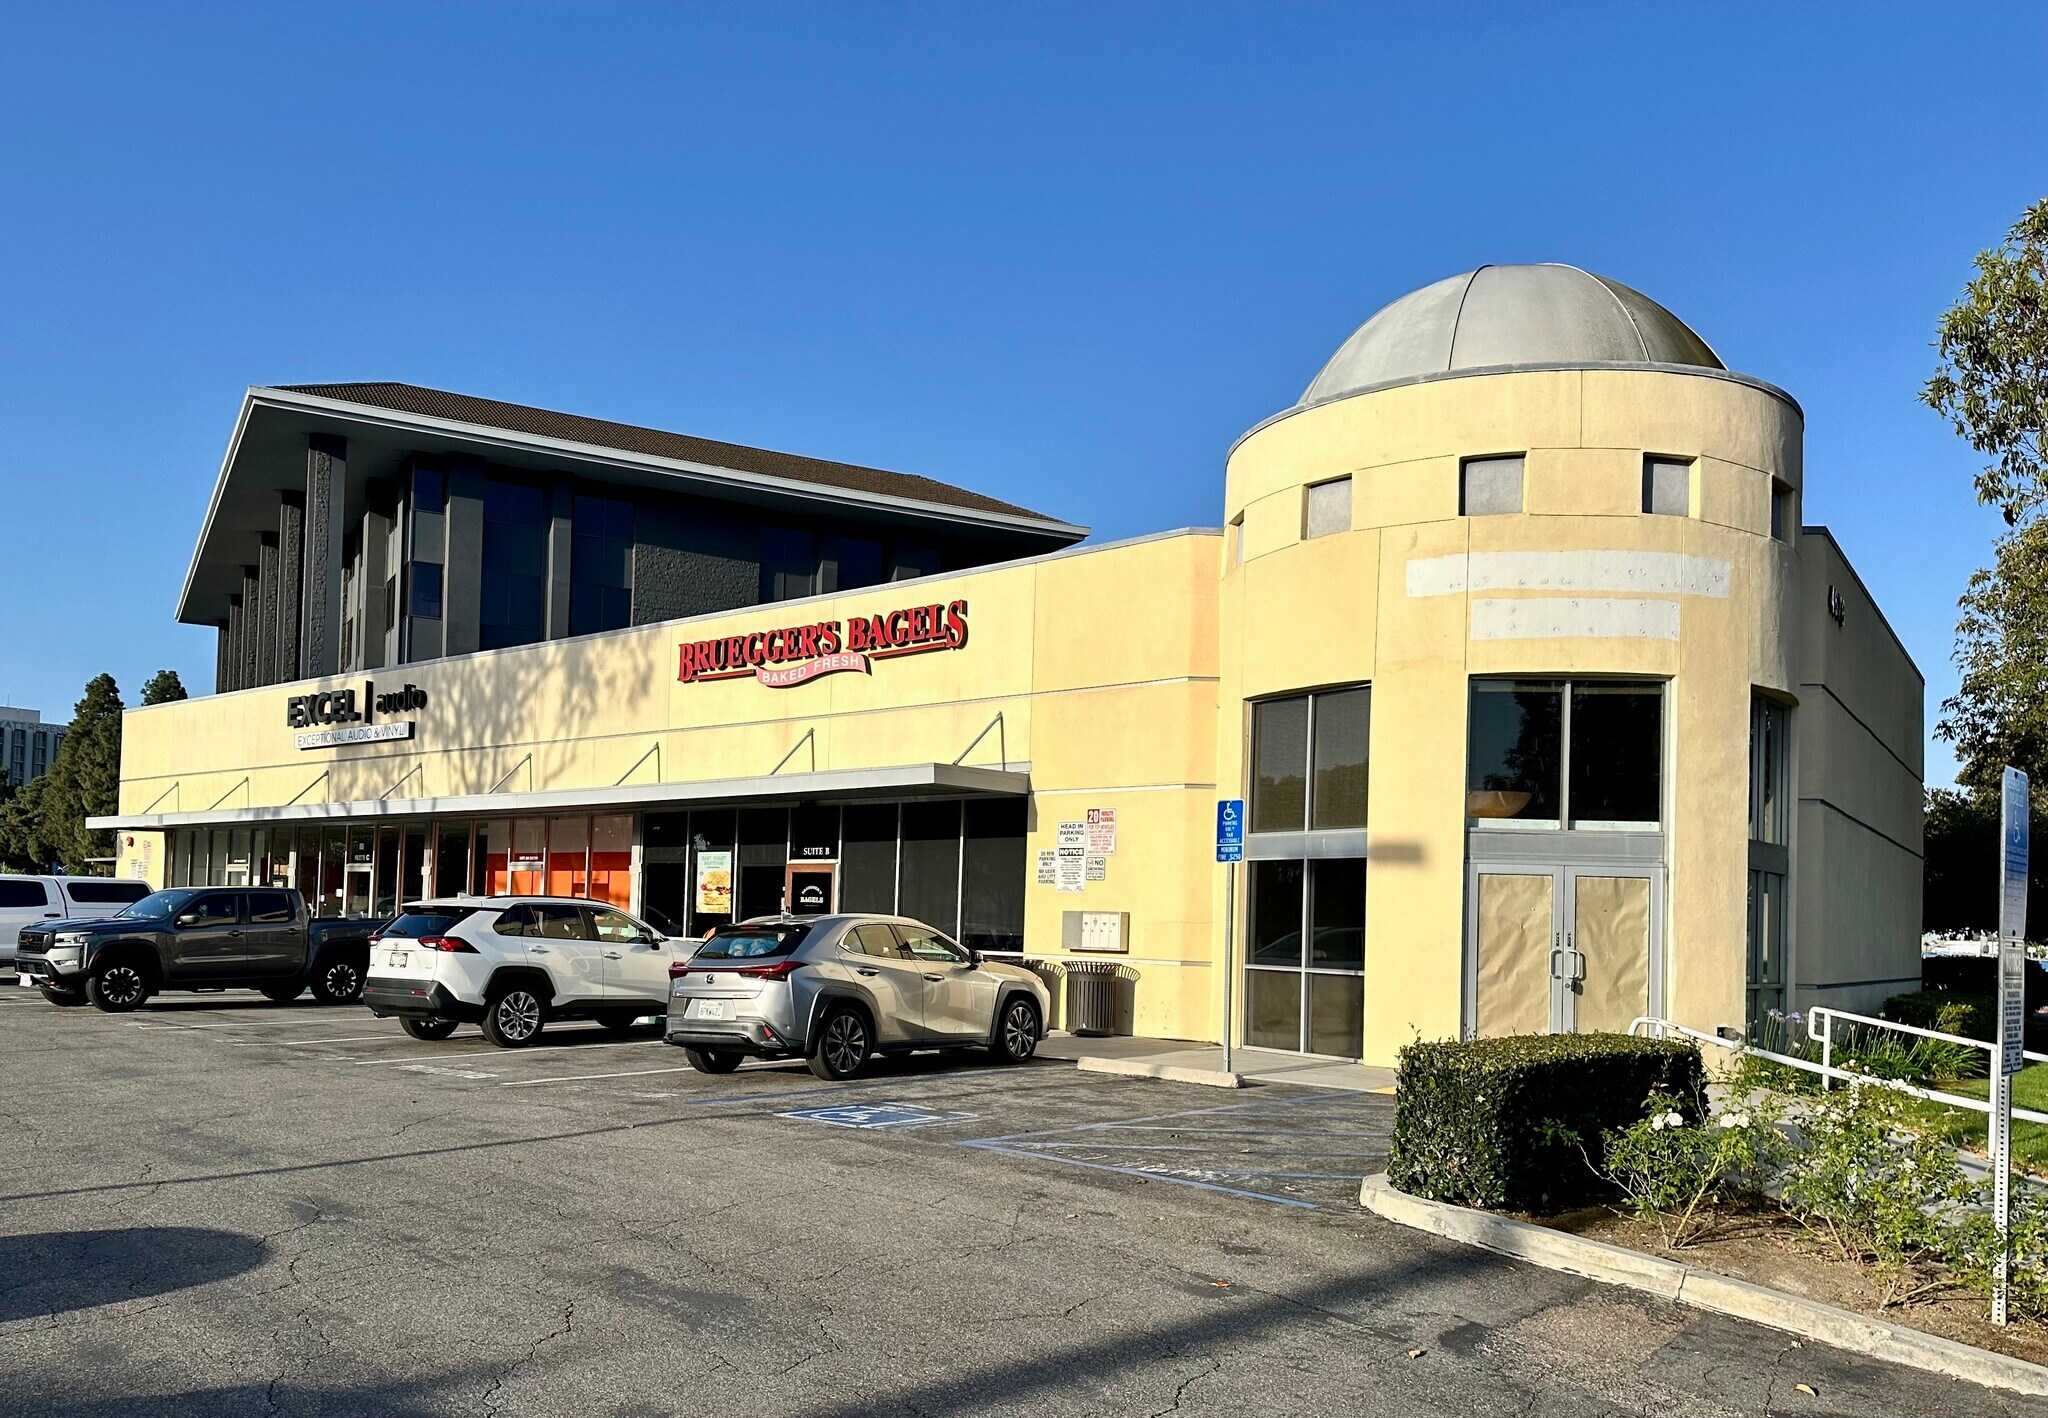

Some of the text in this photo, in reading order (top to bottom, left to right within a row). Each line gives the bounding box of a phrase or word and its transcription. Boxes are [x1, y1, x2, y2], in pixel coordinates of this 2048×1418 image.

[677, 599, 969, 684] BRUEGGER'S BAGELS
[762, 655, 859, 684] BAKED FRESH
[287, 683, 428, 729] EXCEL audio
[297, 726, 405, 747] EXCEPTIONAL AUDIO & VINYL
[1088, 810, 1099, 823] 20
[803, 847, 830, 856] SUITE B
[1059, 848, 1084, 856] NOTICE
[800, 896, 824, 904] BAGELS
